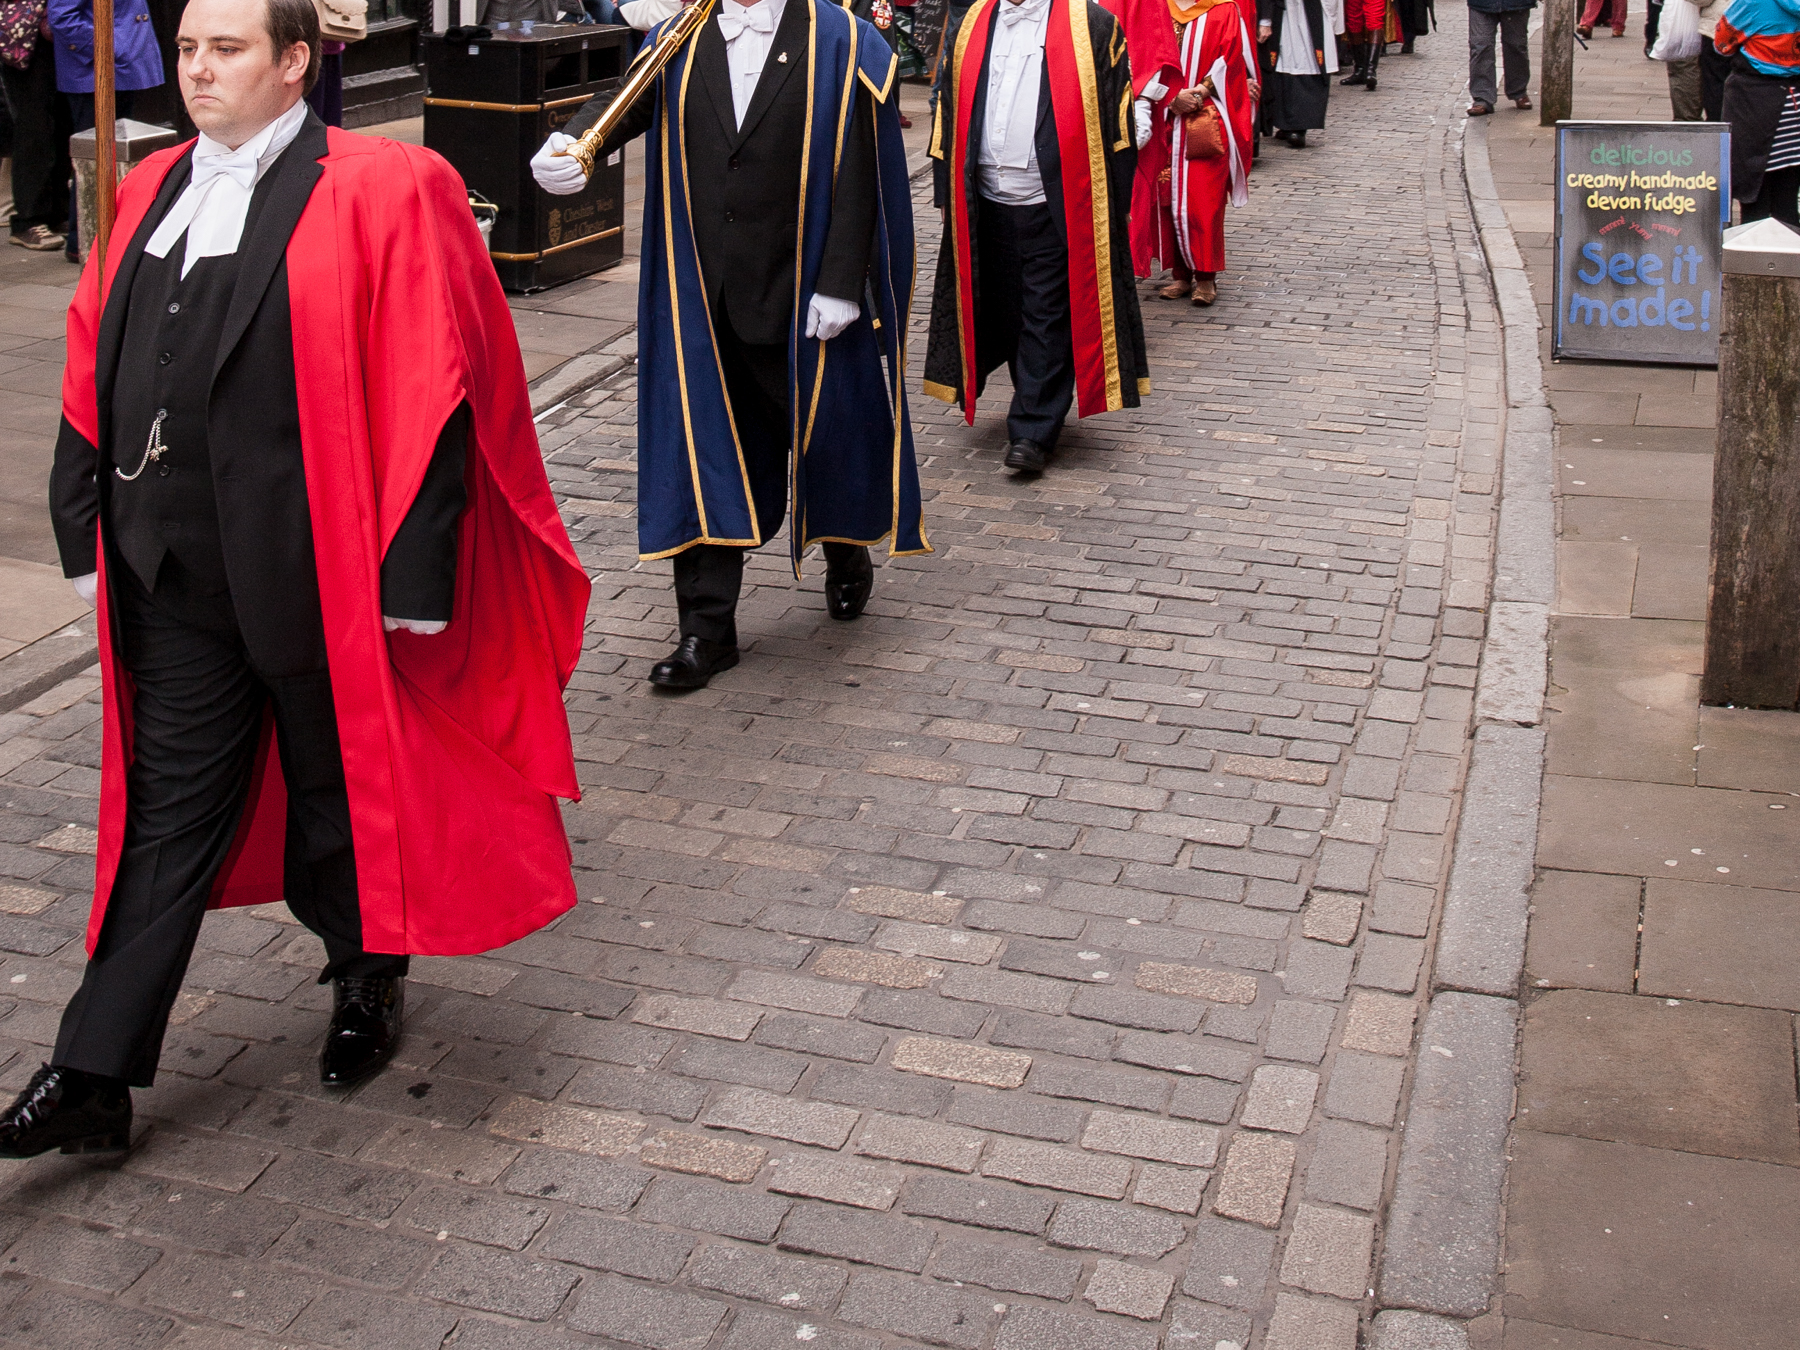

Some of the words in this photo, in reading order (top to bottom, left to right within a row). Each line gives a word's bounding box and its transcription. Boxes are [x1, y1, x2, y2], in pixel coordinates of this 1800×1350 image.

[1590, 142, 1694, 167] delicious
[1566, 172, 1628, 192] creamy
[1630, 170, 1718, 191] handmade
[1586, 190, 1641, 211] devon
[1643, 191, 1697, 215] fudge
[1577, 242, 1666, 286] See
[1671, 244, 1703, 285] it
[1568, 286, 1712, 333] made!
